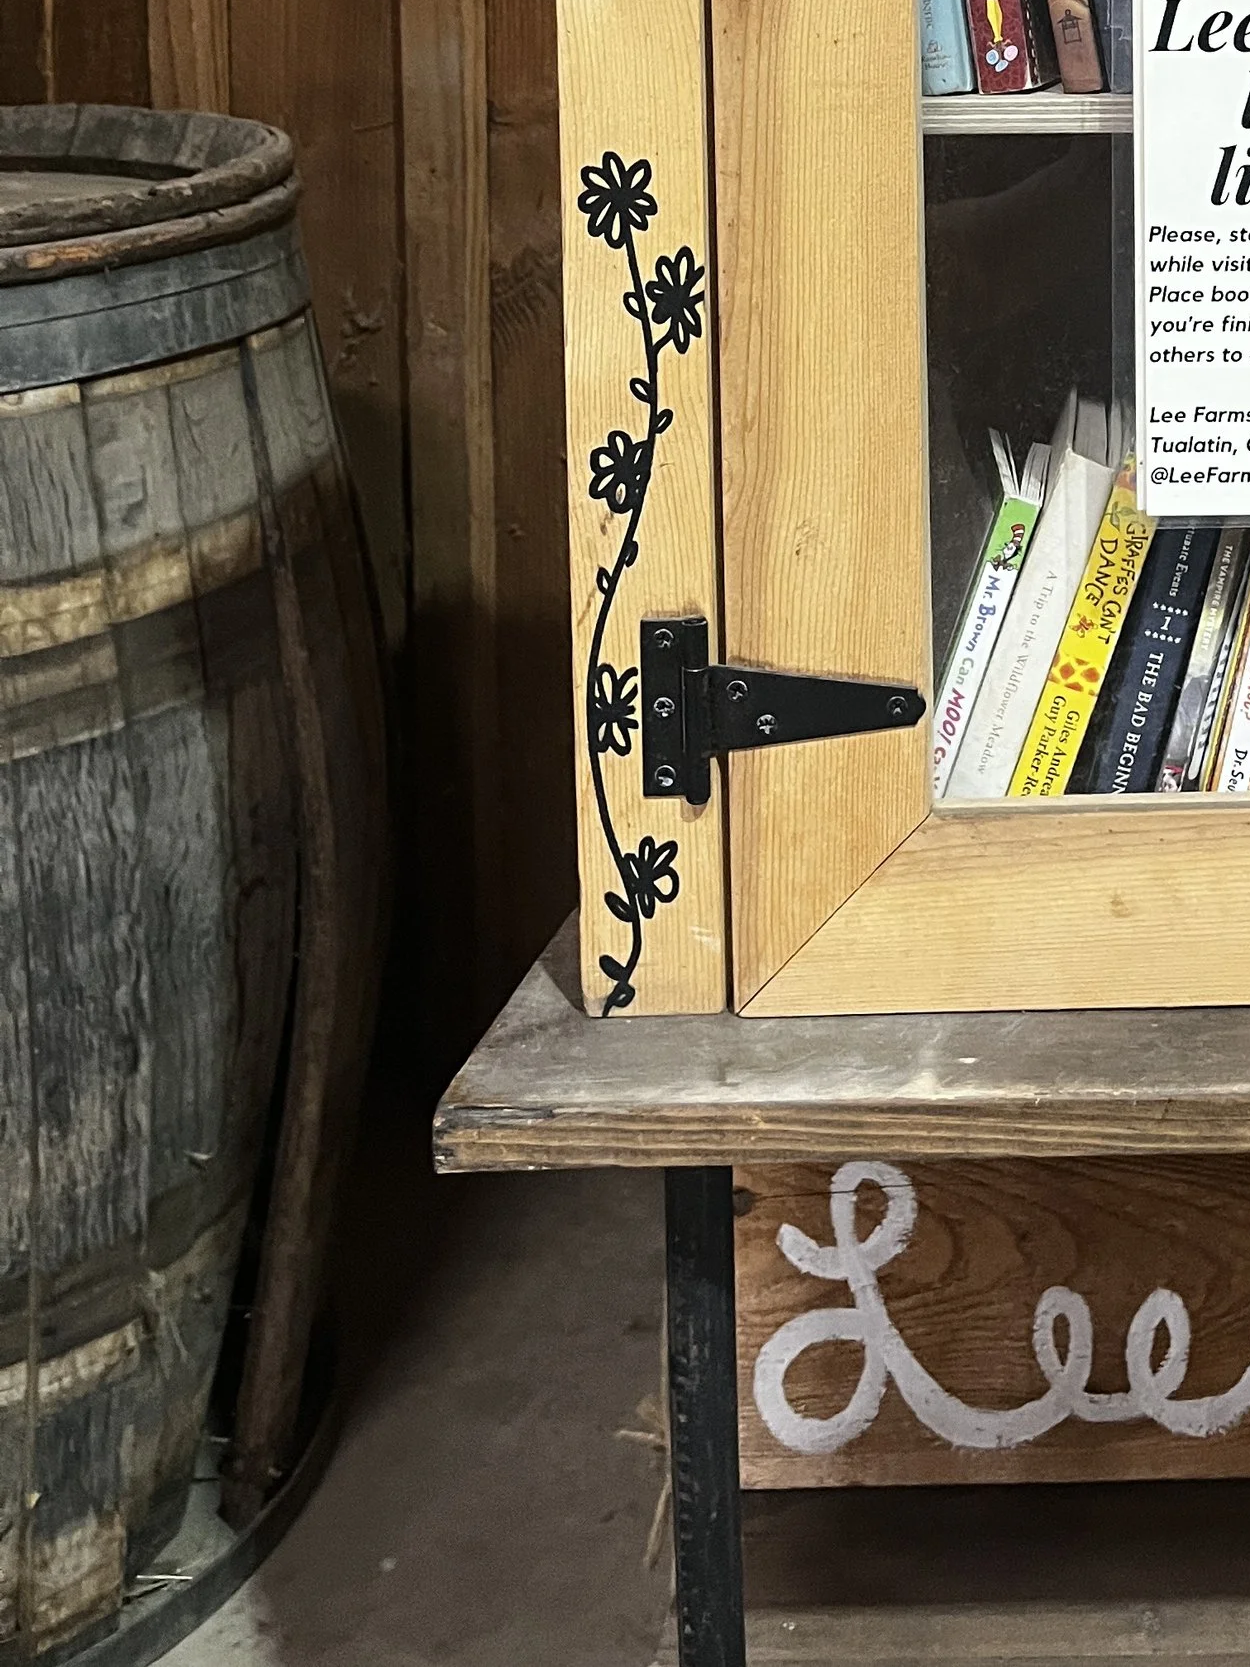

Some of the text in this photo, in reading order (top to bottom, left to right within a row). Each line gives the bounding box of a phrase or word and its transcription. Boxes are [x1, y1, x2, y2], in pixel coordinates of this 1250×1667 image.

[1149, 226, 1221, 245] Please,
[1150, 255, 1204, 272] while
[1149, 286, 1204, 302] Place
[1150, 315, 1214, 336] you're
[1149, 346, 1215, 363] others
[1222, 349, 1243, 363] to
[1150, 407, 1187, 423] Lee
[1151, 436, 1238, 455] Tualatin,
[983, 575, 1000, 599] Mr.
[1086, 538, 1118, 607] DANCE
[1098, 523, 1149, 644] GIRAFFES CAN'T
[1169, 563, 1188, 597] Events
[1201, 545, 1234, 650] THE VAMPIRE MYSTERY
[965, 605, 997, 653] Brown
[1160, 616, 1172, 631] 1
[955, 657, 974, 685] Can
[977, 571, 1057, 774] A Trip to the Wildflower Meadow
[937, 687, 965, 745] MOO!
[1112, 652, 1164, 794] THE BAD BEGINN
[1021, 696, 1067, 796] Guy Parker-Re
[1040, 710, 1080, 796] Giles Andrea
[1227, 748, 1248, 792] Dr. Seu
